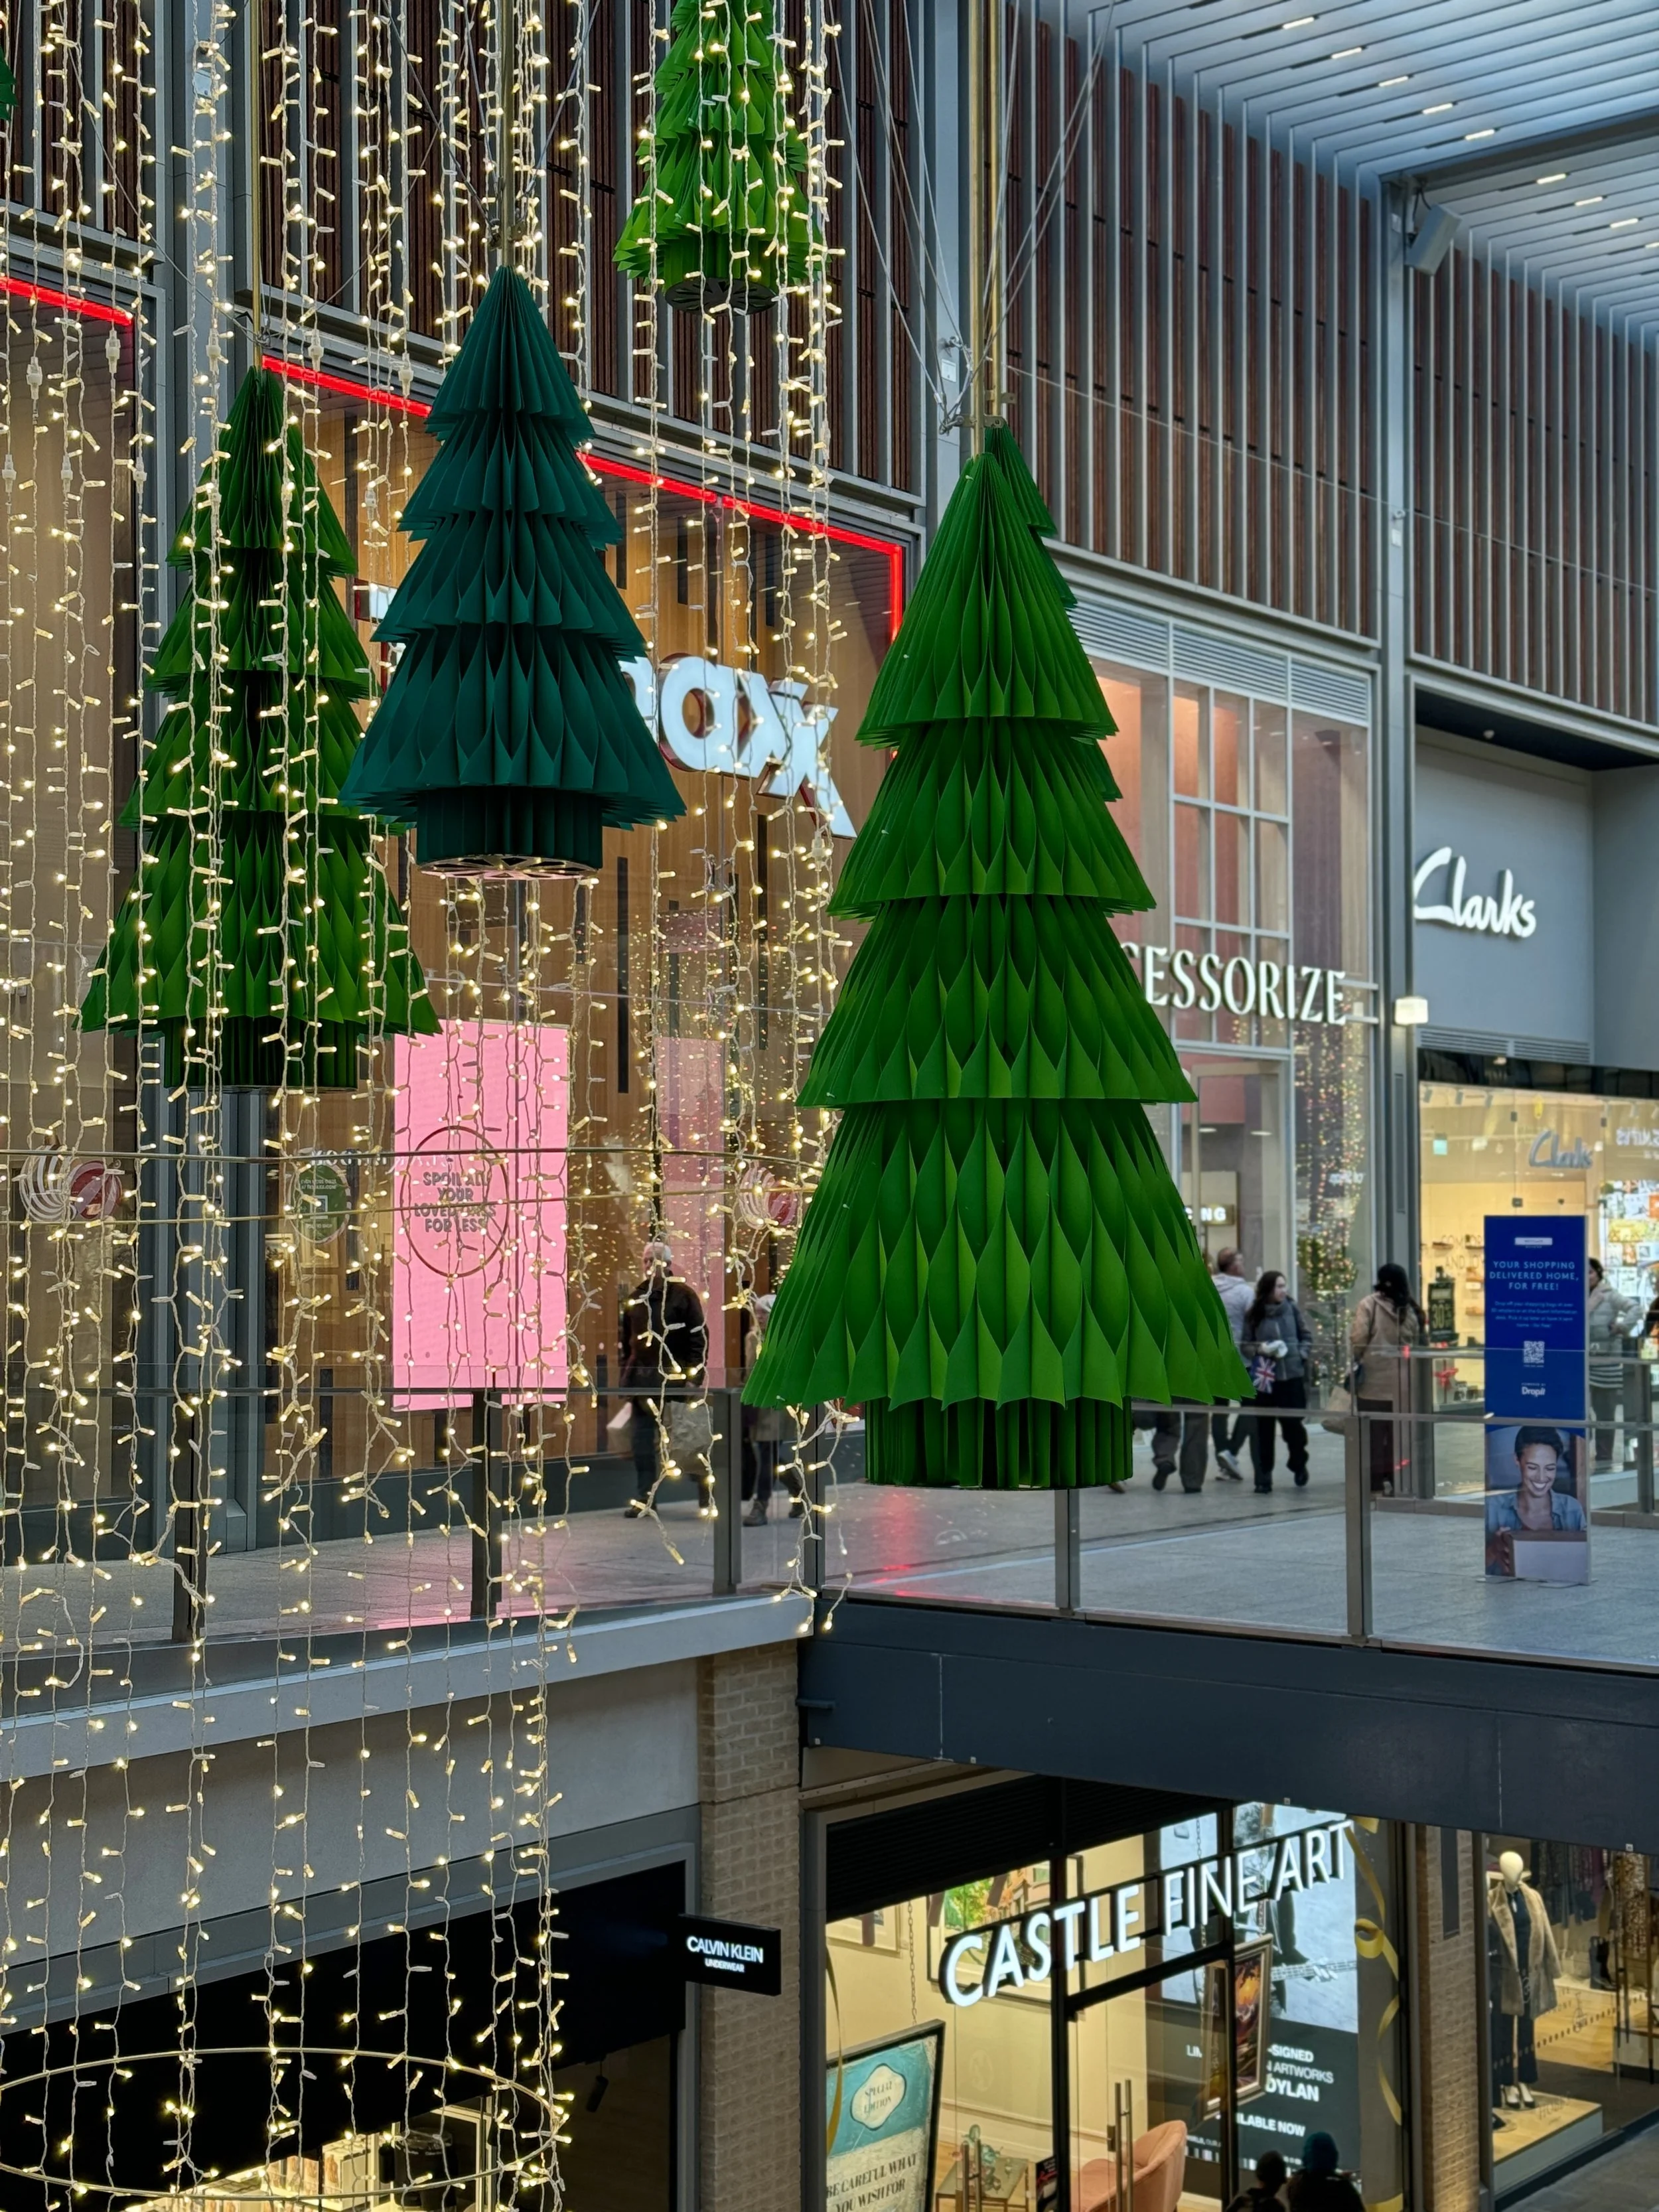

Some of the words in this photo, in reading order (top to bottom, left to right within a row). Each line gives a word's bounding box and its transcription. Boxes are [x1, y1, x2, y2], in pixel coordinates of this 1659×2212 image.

[1413, 847, 1536, 937] Clarks
[423, 1171, 464, 1187] SPOIL
[437, 1187, 474, 1202] YOUR
[415, 1202, 456, 1217] LOVED
[425, 1218, 455, 1232] FOR
[1546, 1272, 1579, 1281] HOME,
[946, 1883, 1141, 2007] CASTLE
[1163, 1848, 1258, 1937] FINE
[1274, 1819, 1354, 1901] ART
[687, 1935, 729, 1958] CALVIN
[729, 1941, 763, 1963] KLEIN
[705, 1958, 745, 1972] UNDERWEAR
[1273, 2063, 1334, 2084] ARTWORKS
[1265, 2075, 1319, 2102] DYLAN
[864, 2096, 891, 2114] EDITION
[1277, 2120, 1306, 2137] NOW
[841, 2165, 887, 2193] CAREFUL
[889, 2152, 917, 2174] WHAT
[835, 2199, 857, 2212] YOU
[858, 2183, 886, 2208] WISH
[886, 2177, 906, 2194] FOR
